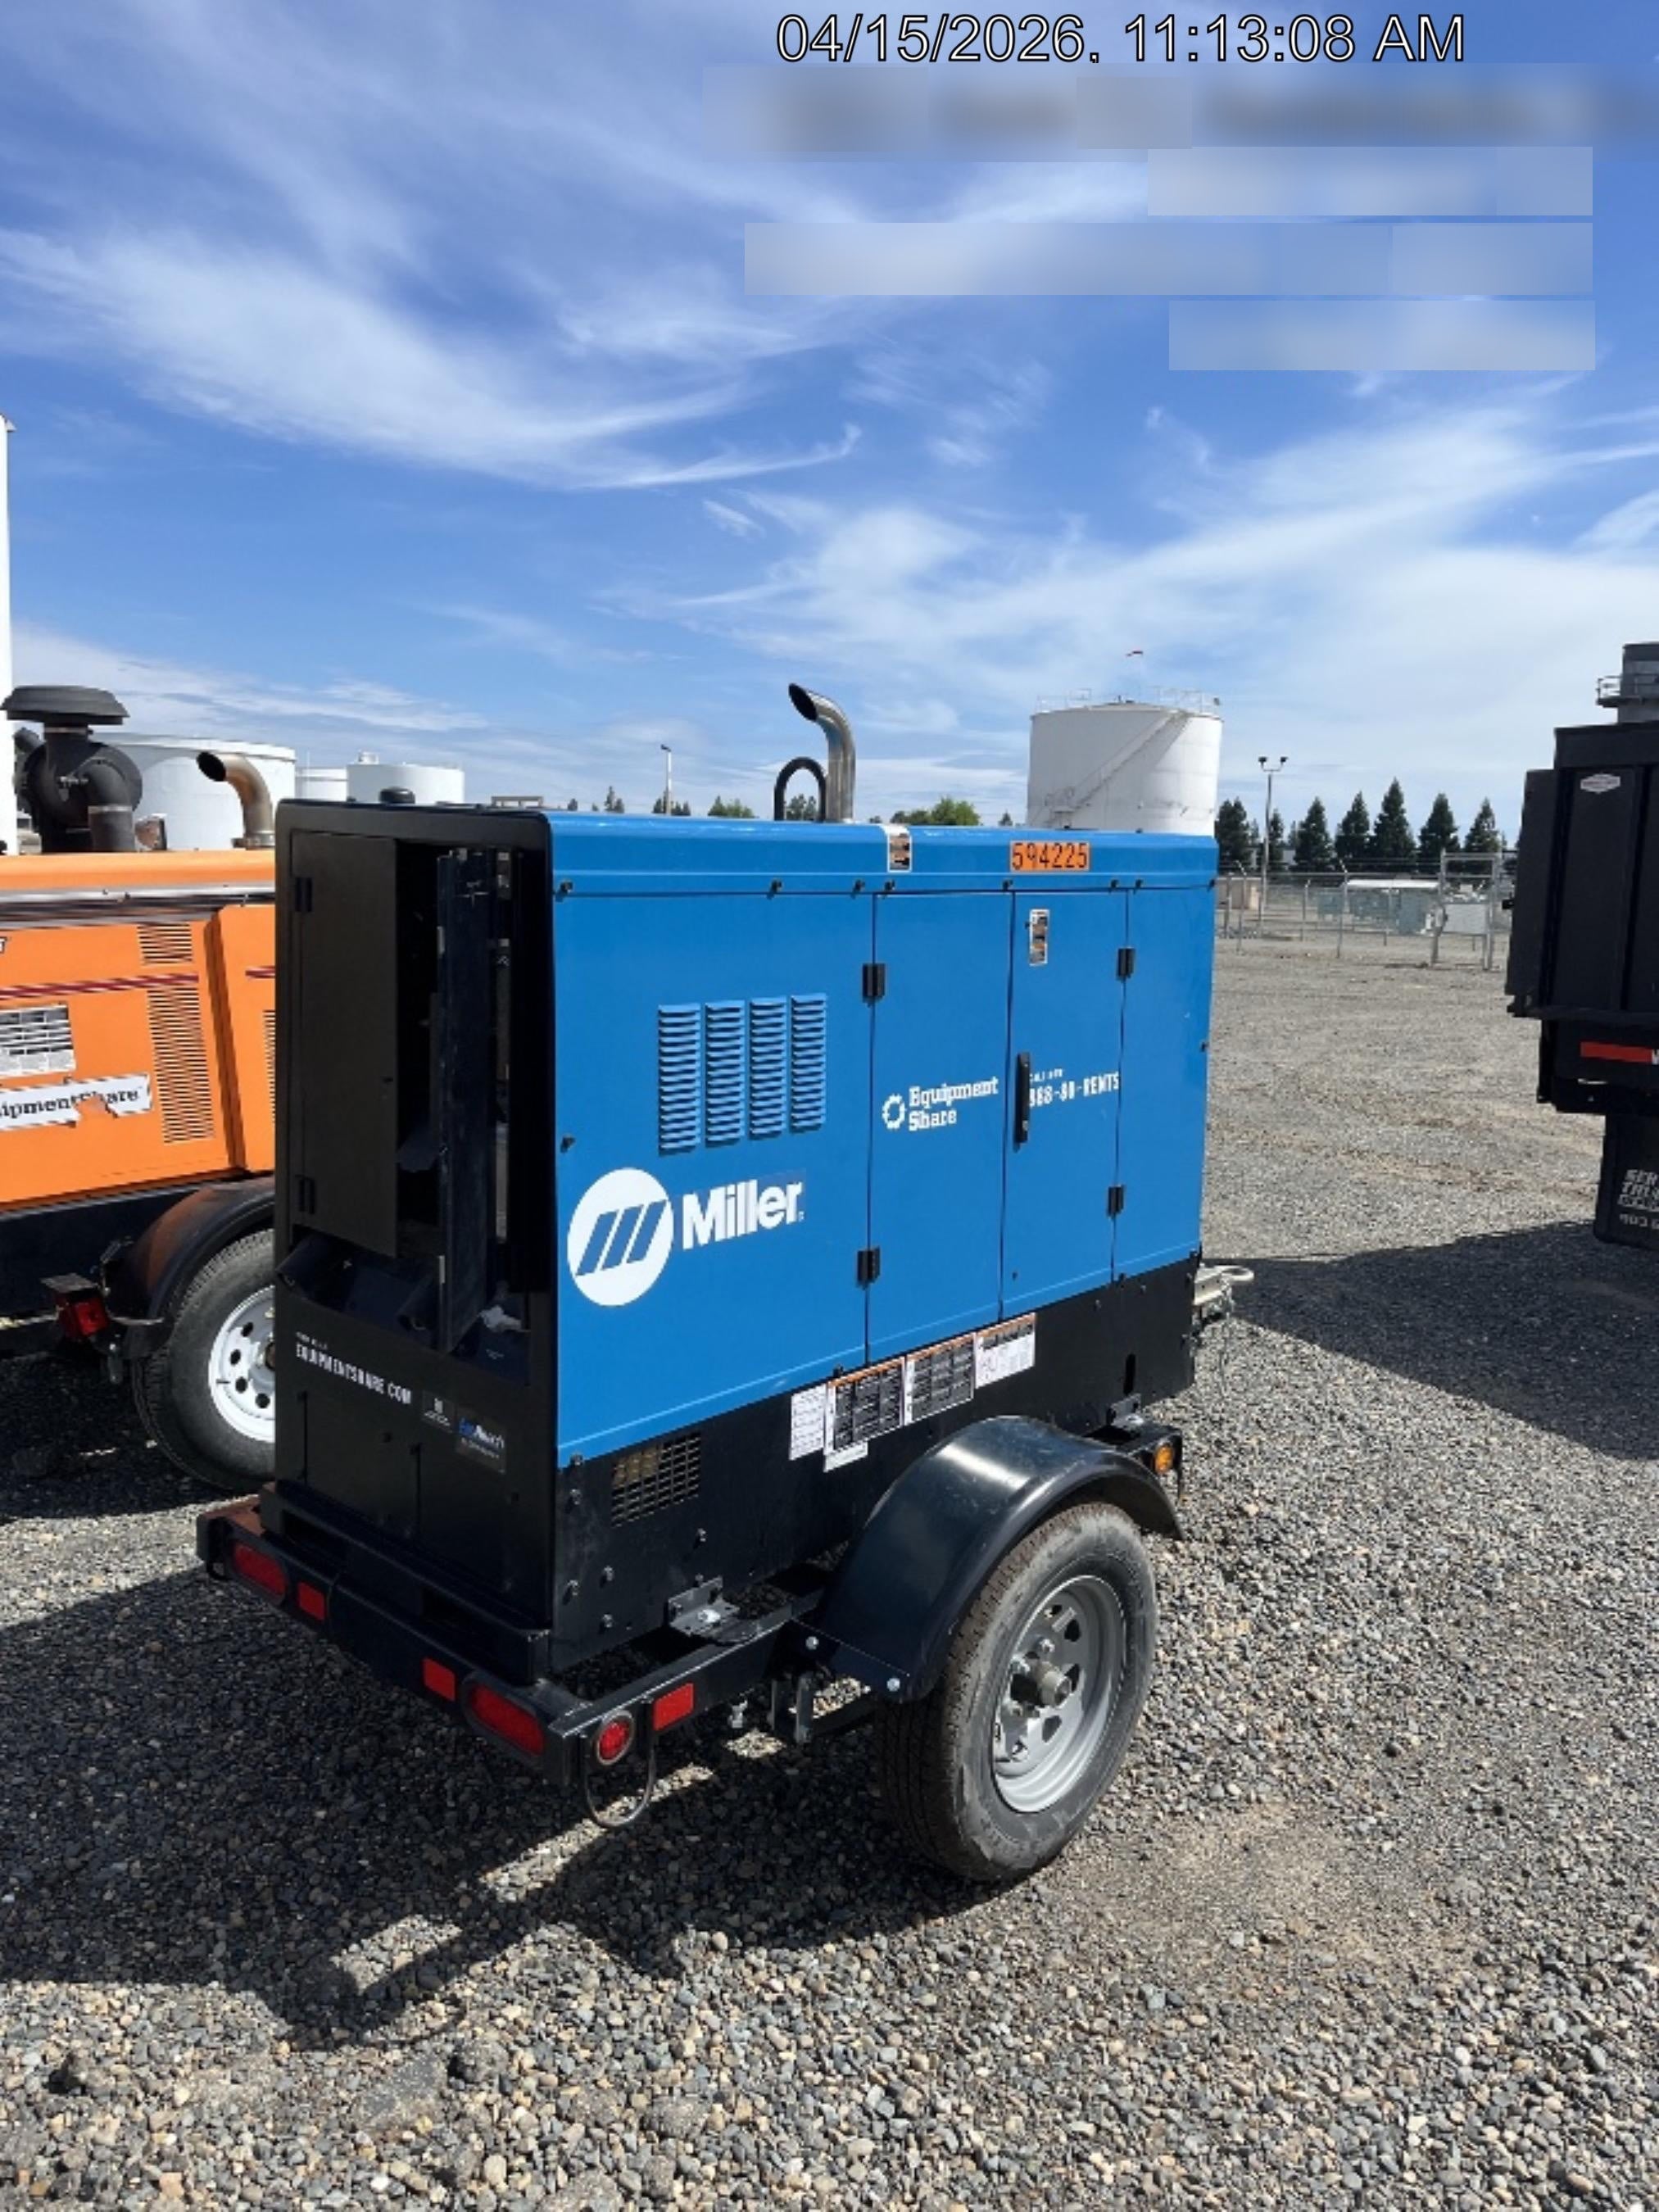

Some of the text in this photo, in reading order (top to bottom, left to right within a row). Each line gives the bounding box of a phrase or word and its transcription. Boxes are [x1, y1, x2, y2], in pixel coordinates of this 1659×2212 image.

[1013, 842, 1087, 870] 594225
[909, 1076, 999, 1105] Equipment
[909, 1109, 957, 1131] Share
[682, 1180, 803, 1251] Miller
